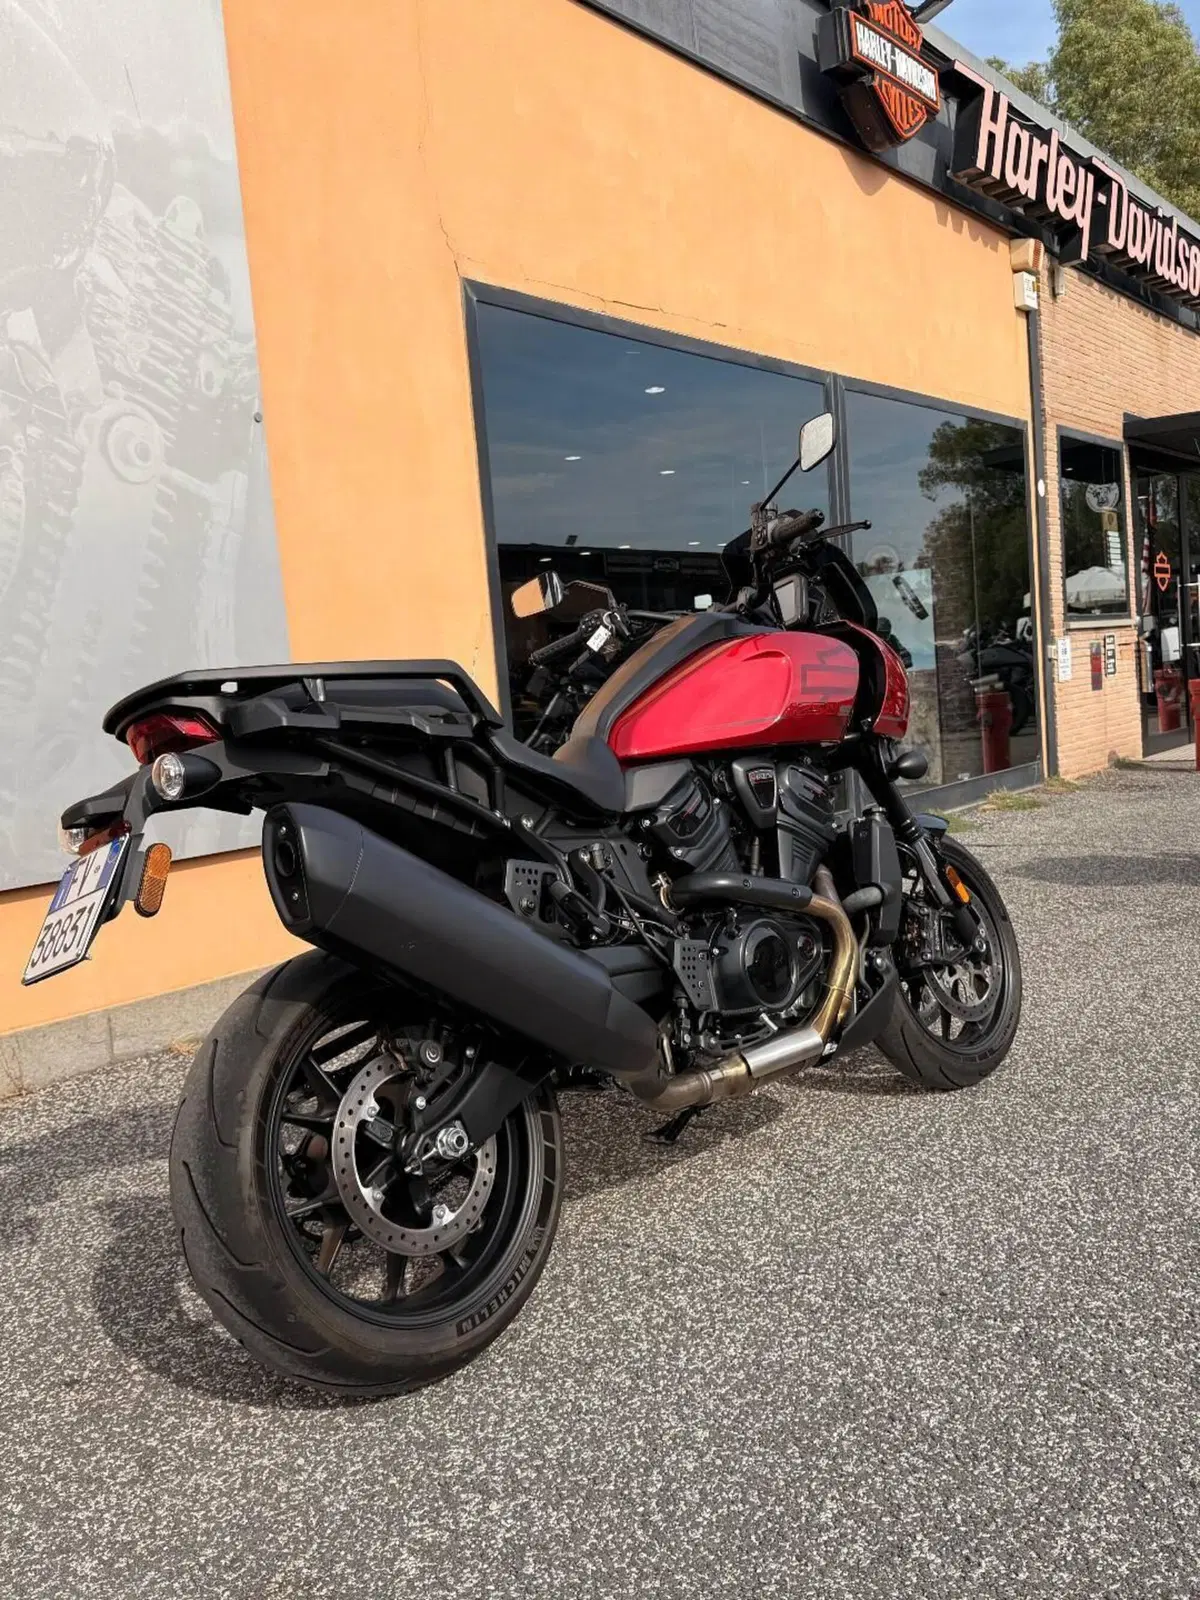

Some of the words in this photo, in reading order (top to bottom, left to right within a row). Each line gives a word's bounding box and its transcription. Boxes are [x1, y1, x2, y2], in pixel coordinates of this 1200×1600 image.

[872, 2, 922, 51] MOTOR
[855, 21, 936, 101] HARLEY-DAVIDSON
[881, 79, 925, 129] CYCLES
[31, 902, 95, 967] 38831
[461, 1254, 532, 1333] MICHELIN
